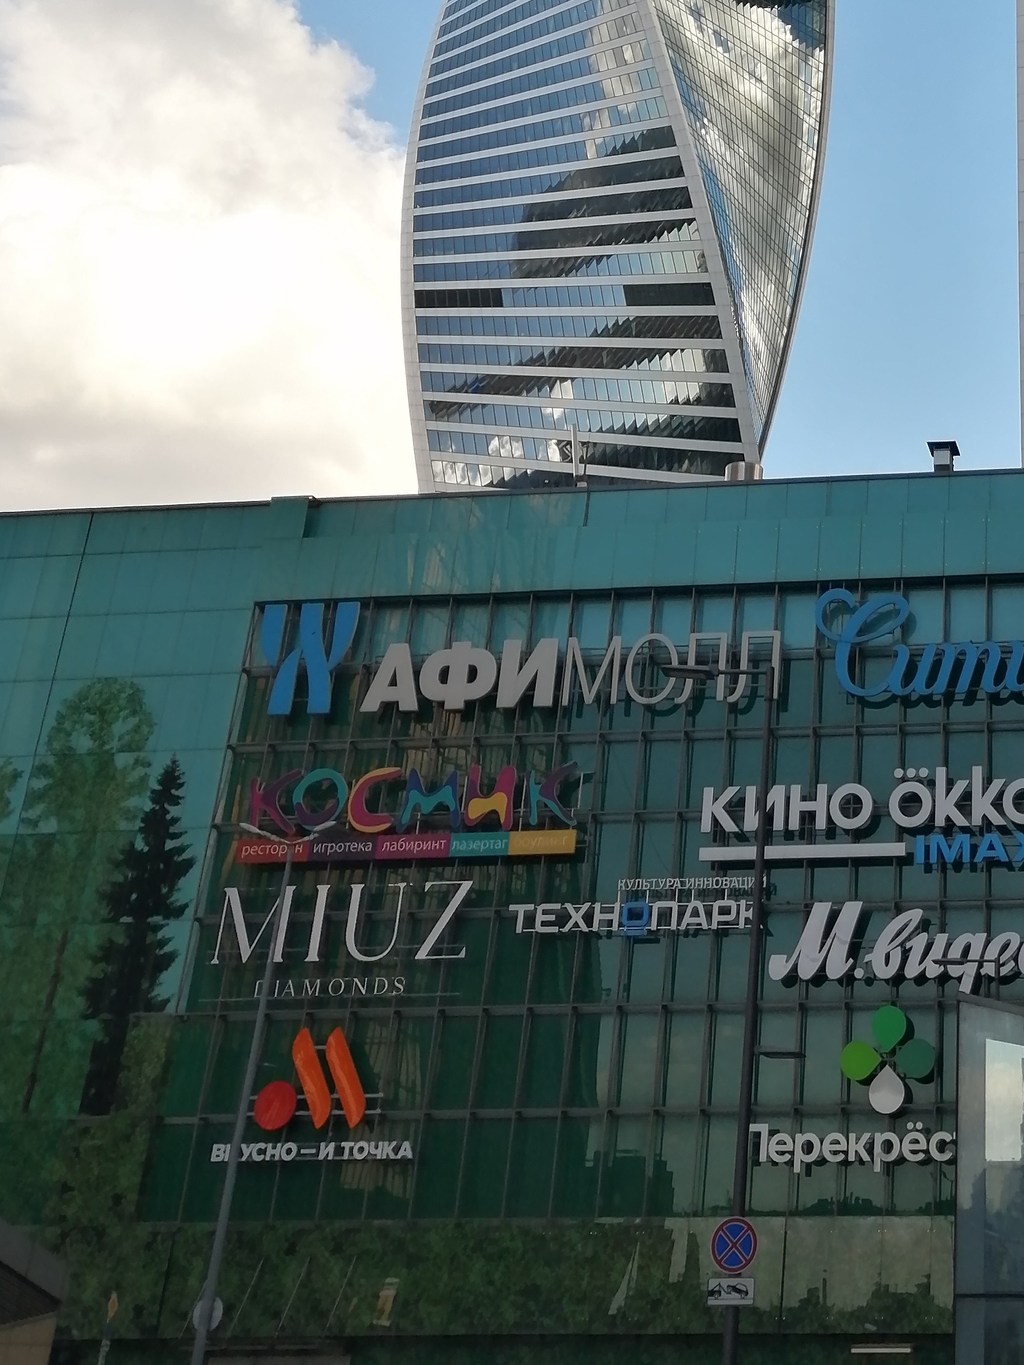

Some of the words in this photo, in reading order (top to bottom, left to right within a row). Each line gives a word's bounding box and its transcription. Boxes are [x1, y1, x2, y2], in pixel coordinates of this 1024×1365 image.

[360, 629, 781, 714] АФИМОЛЛ
[701, 783, 873, 833] КИНО
[241, 843, 304, 858] ресторн
[313, 840, 374, 856] игротека
[381, 837, 447, 854] лабиринт
[451, 838, 508, 853] лазертаг
[618, 876, 682, 890] КУЛЬТУРА
[210, 880, 474, 965] MIUZ
[254, 976, 406, 998] DIAMONDS
[340, 1140, 414, 1160] ТОЧКА
[749, 1121, 957, 1173] Перекрёс
